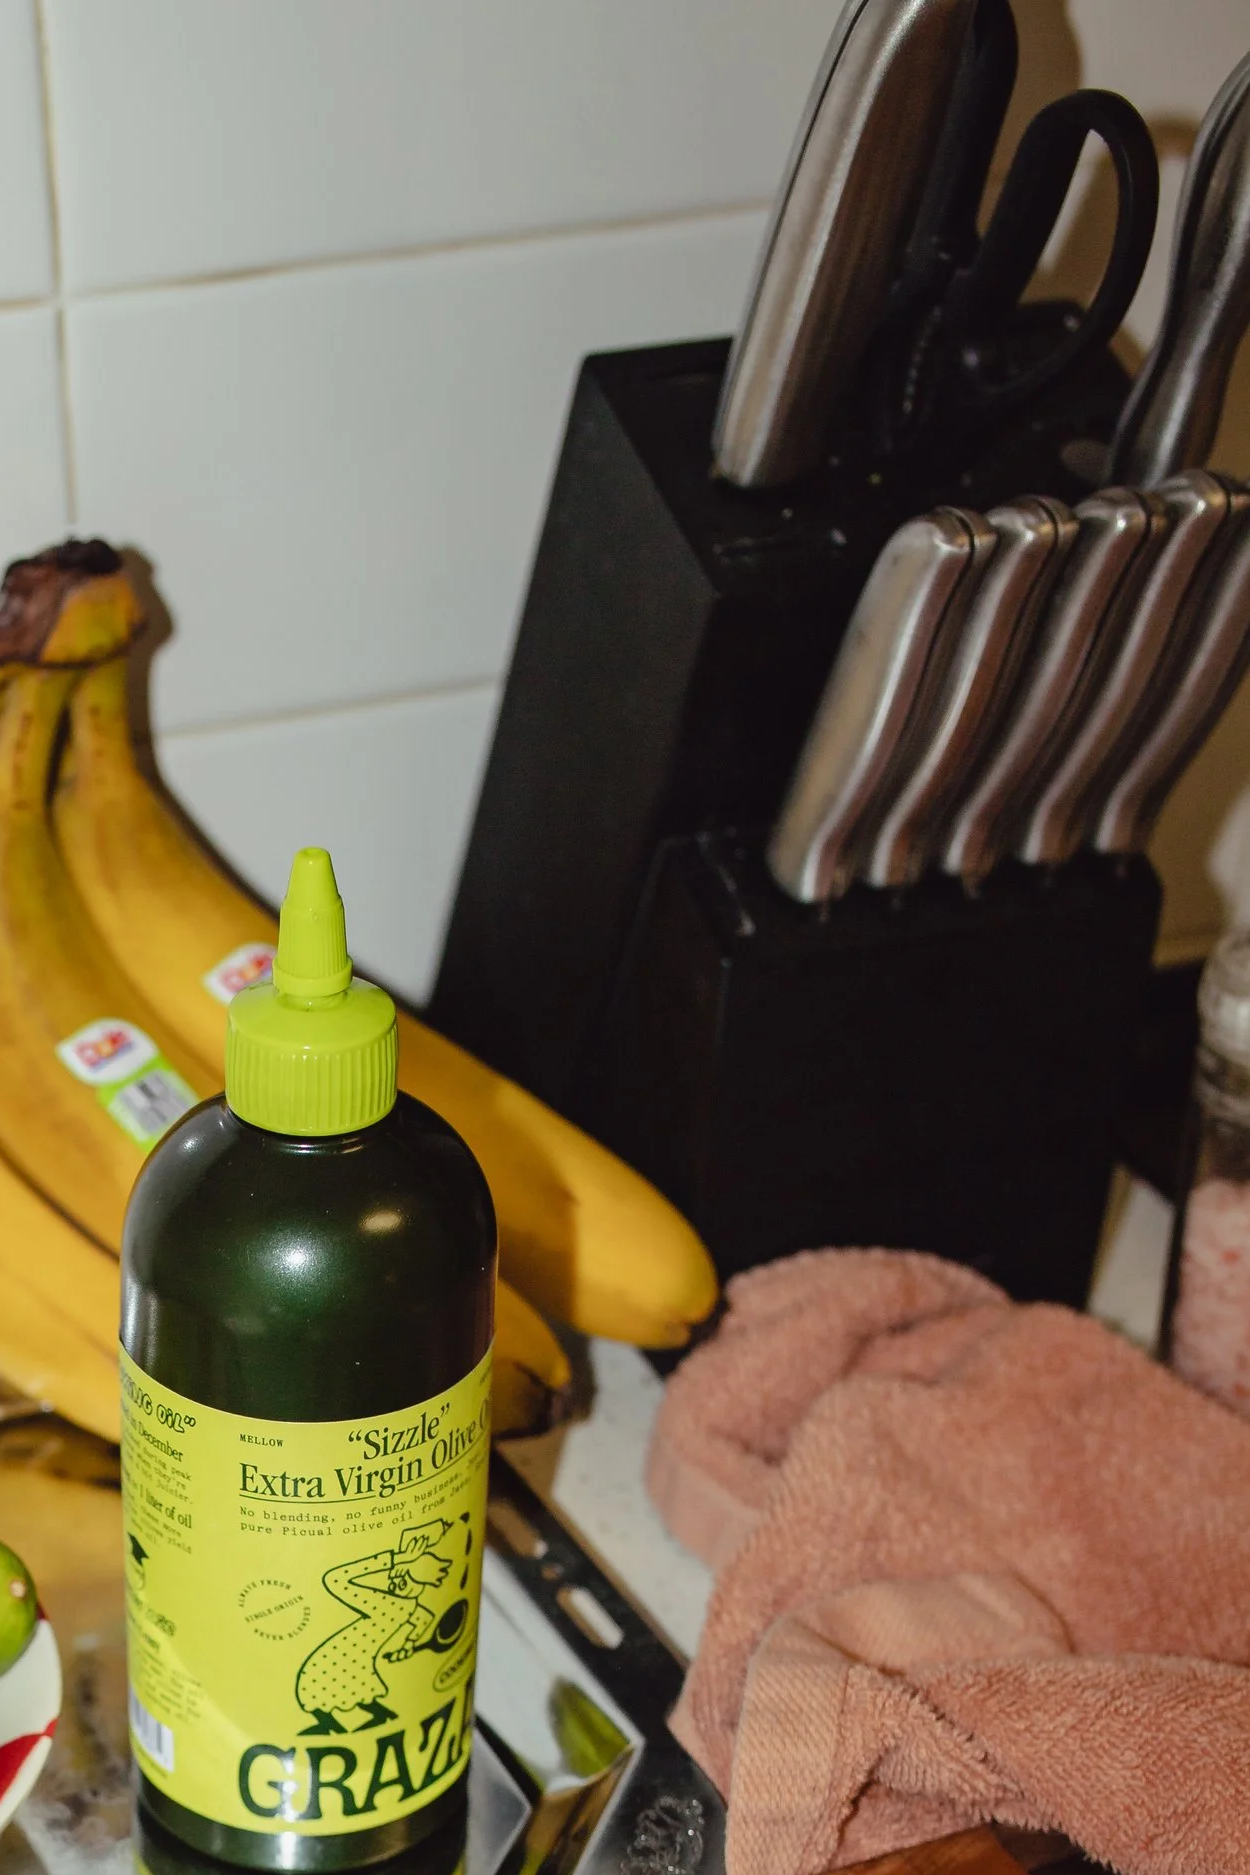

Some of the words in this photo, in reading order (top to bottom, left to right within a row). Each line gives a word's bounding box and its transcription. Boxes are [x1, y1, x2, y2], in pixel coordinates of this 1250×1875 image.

[138, 1421, 183, 1462] December
[239, 1433, 284, 1447] MELLOW
[348, 1402, 450, 1461] “Sizzle”
[239, 1462, 326, 1498] Extra
[334, 1456, 423, 1498] Virgin
[431, 1421, 476, 1469] Olive
[165, 1506, 176, 1520] of
[177, 1513, 192, 1529] oil
[239, 1506, 255, 1517] No
[263, 1510, 335, 1523] blending,
[346, 1511, 362, 1521] no
[370, 1500, 406, 1516] funny
[240, 1521, 273, 1534] pure
[282, 1526, 333, 1537] Picual
[342, 1521, 383, 1535] olive
[391, 1511, 413, 1525] oil
[421, 1496, 445, 1514] from
